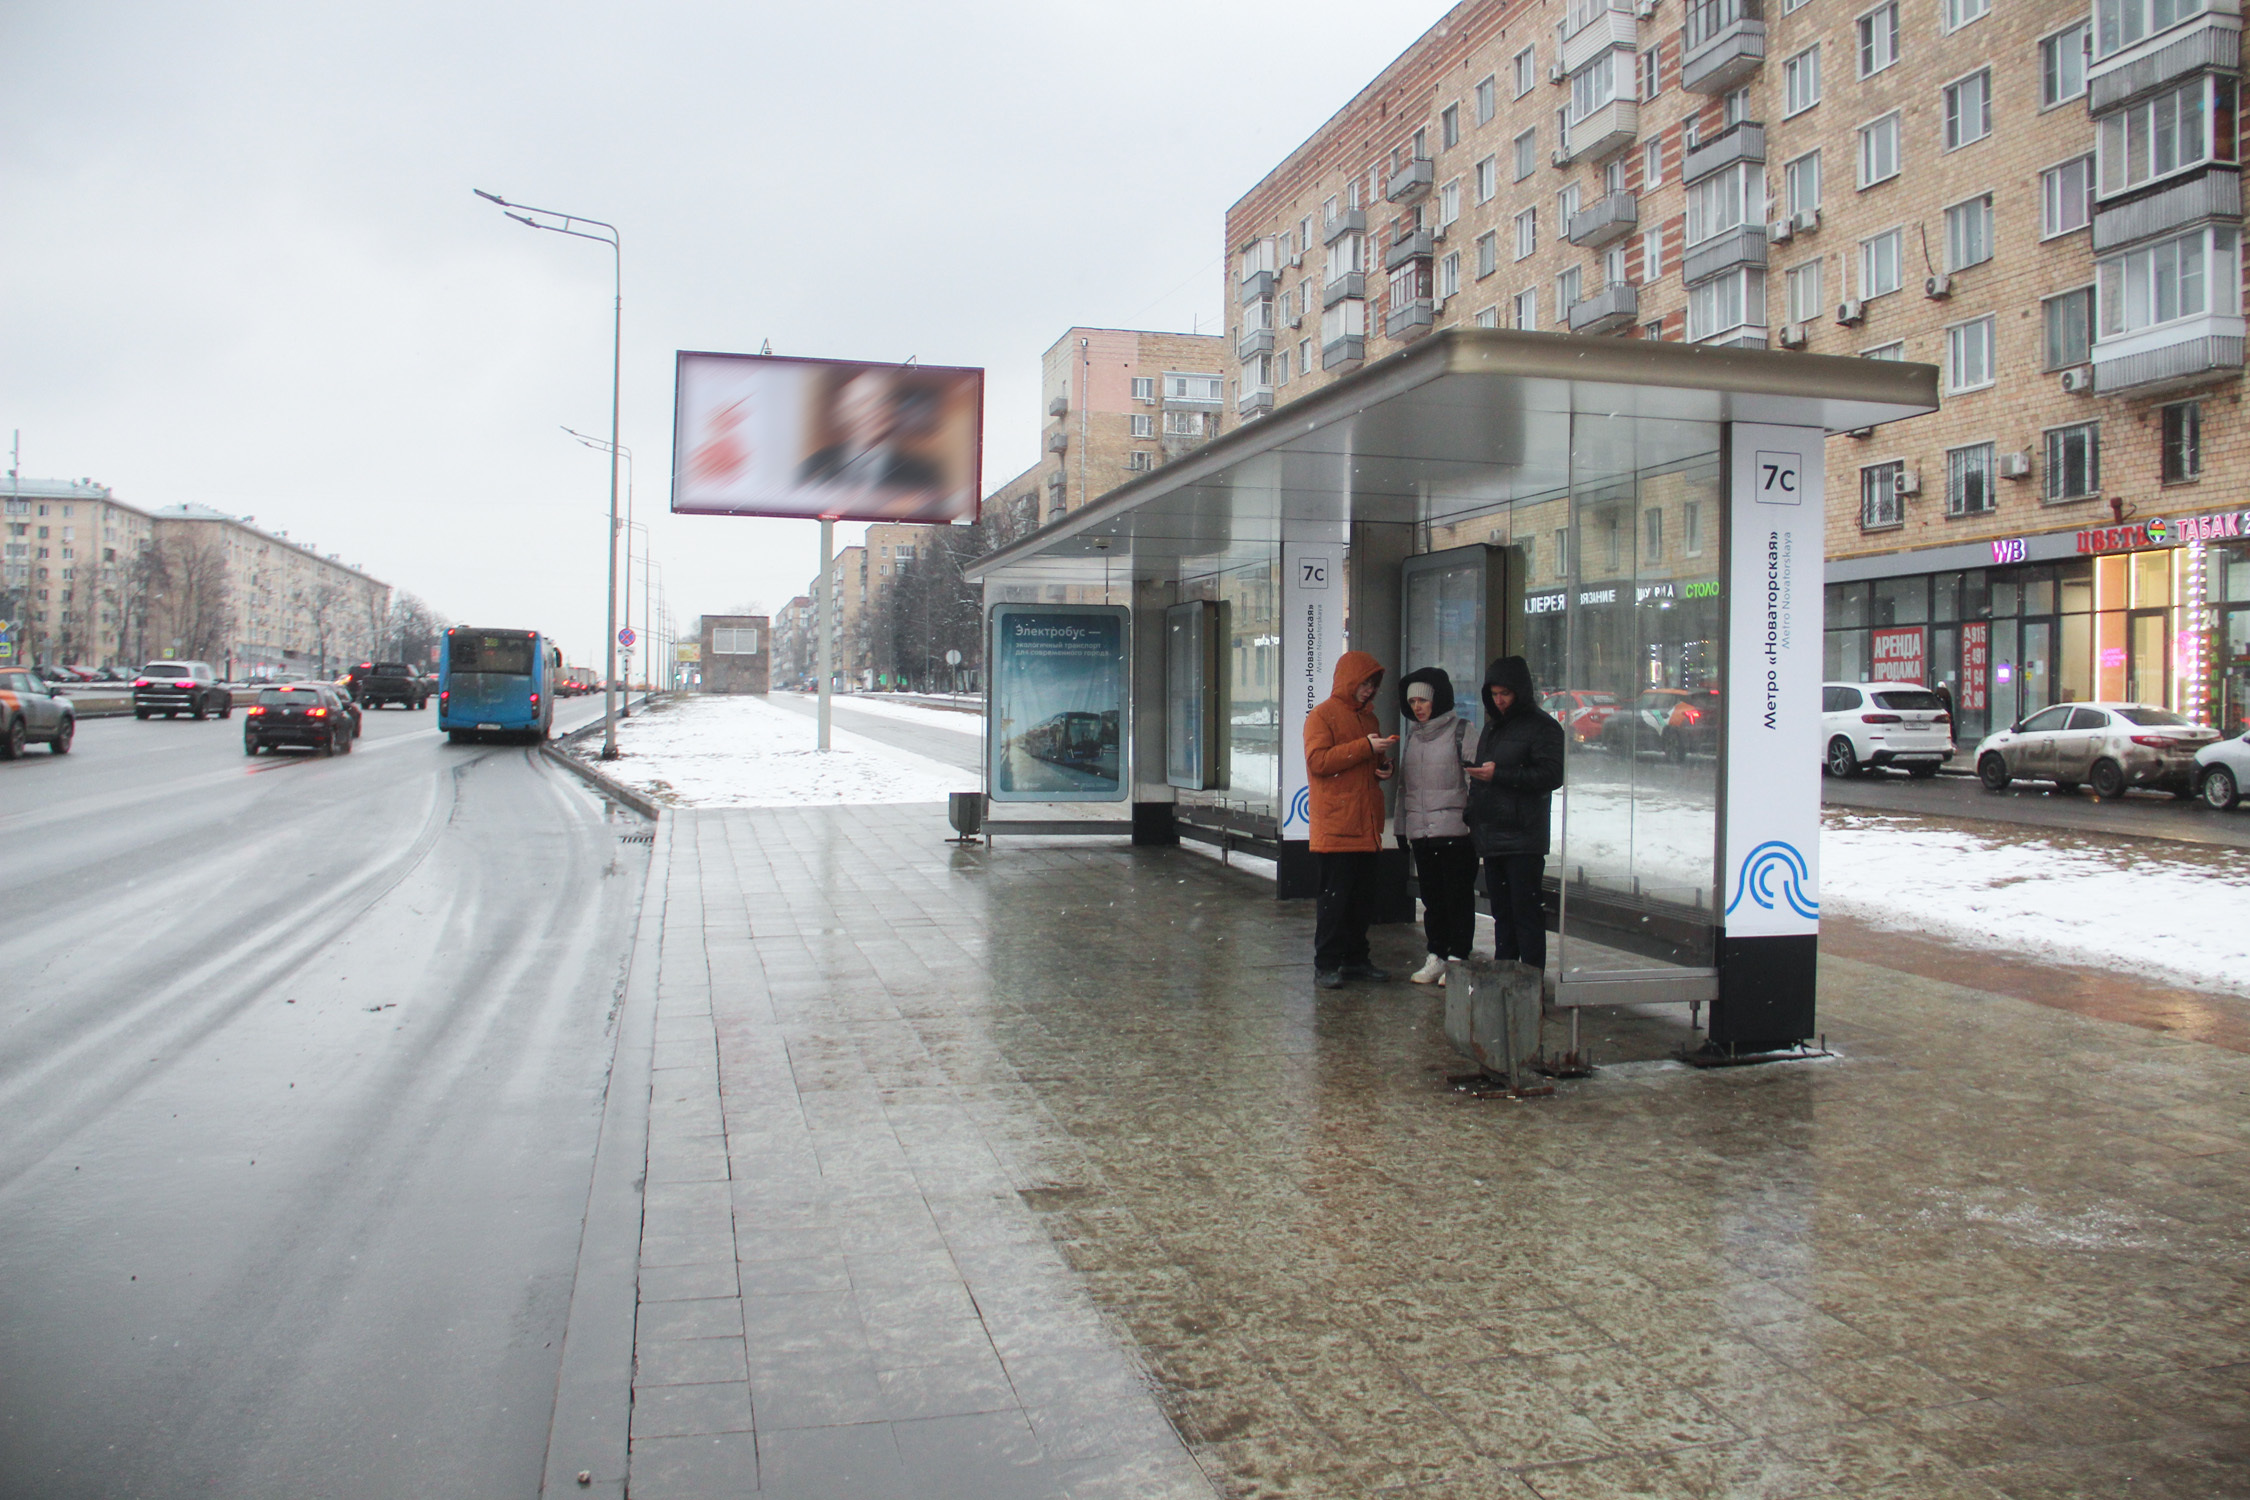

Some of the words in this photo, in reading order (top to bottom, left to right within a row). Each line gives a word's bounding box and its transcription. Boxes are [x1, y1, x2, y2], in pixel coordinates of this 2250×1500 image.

[2175, 512, 2239, 542] ТАБАК
[1991, 538, 2028, 564] WB
[1781, 531, 1792, 609] Novatorskaya
[1764, 530, 1780, 665] «Новаторская»
[1015, 625, 1085, 640] Электробус
[1306, 604, 1315, 684] «Новаторская»
[1781, 612, 1792, 649] Metro
[1874, 633, 1921, 660] АРЕНДА
[1971, 626, 1986, 643] 915
[1875, 660, 1921, 680] ПРОДАЖА
[1963, 626, 1972, 707] АРЕНДА
[1306, 685, 1315, 719] етро
[1763, 670, 1779, 731] Метро
